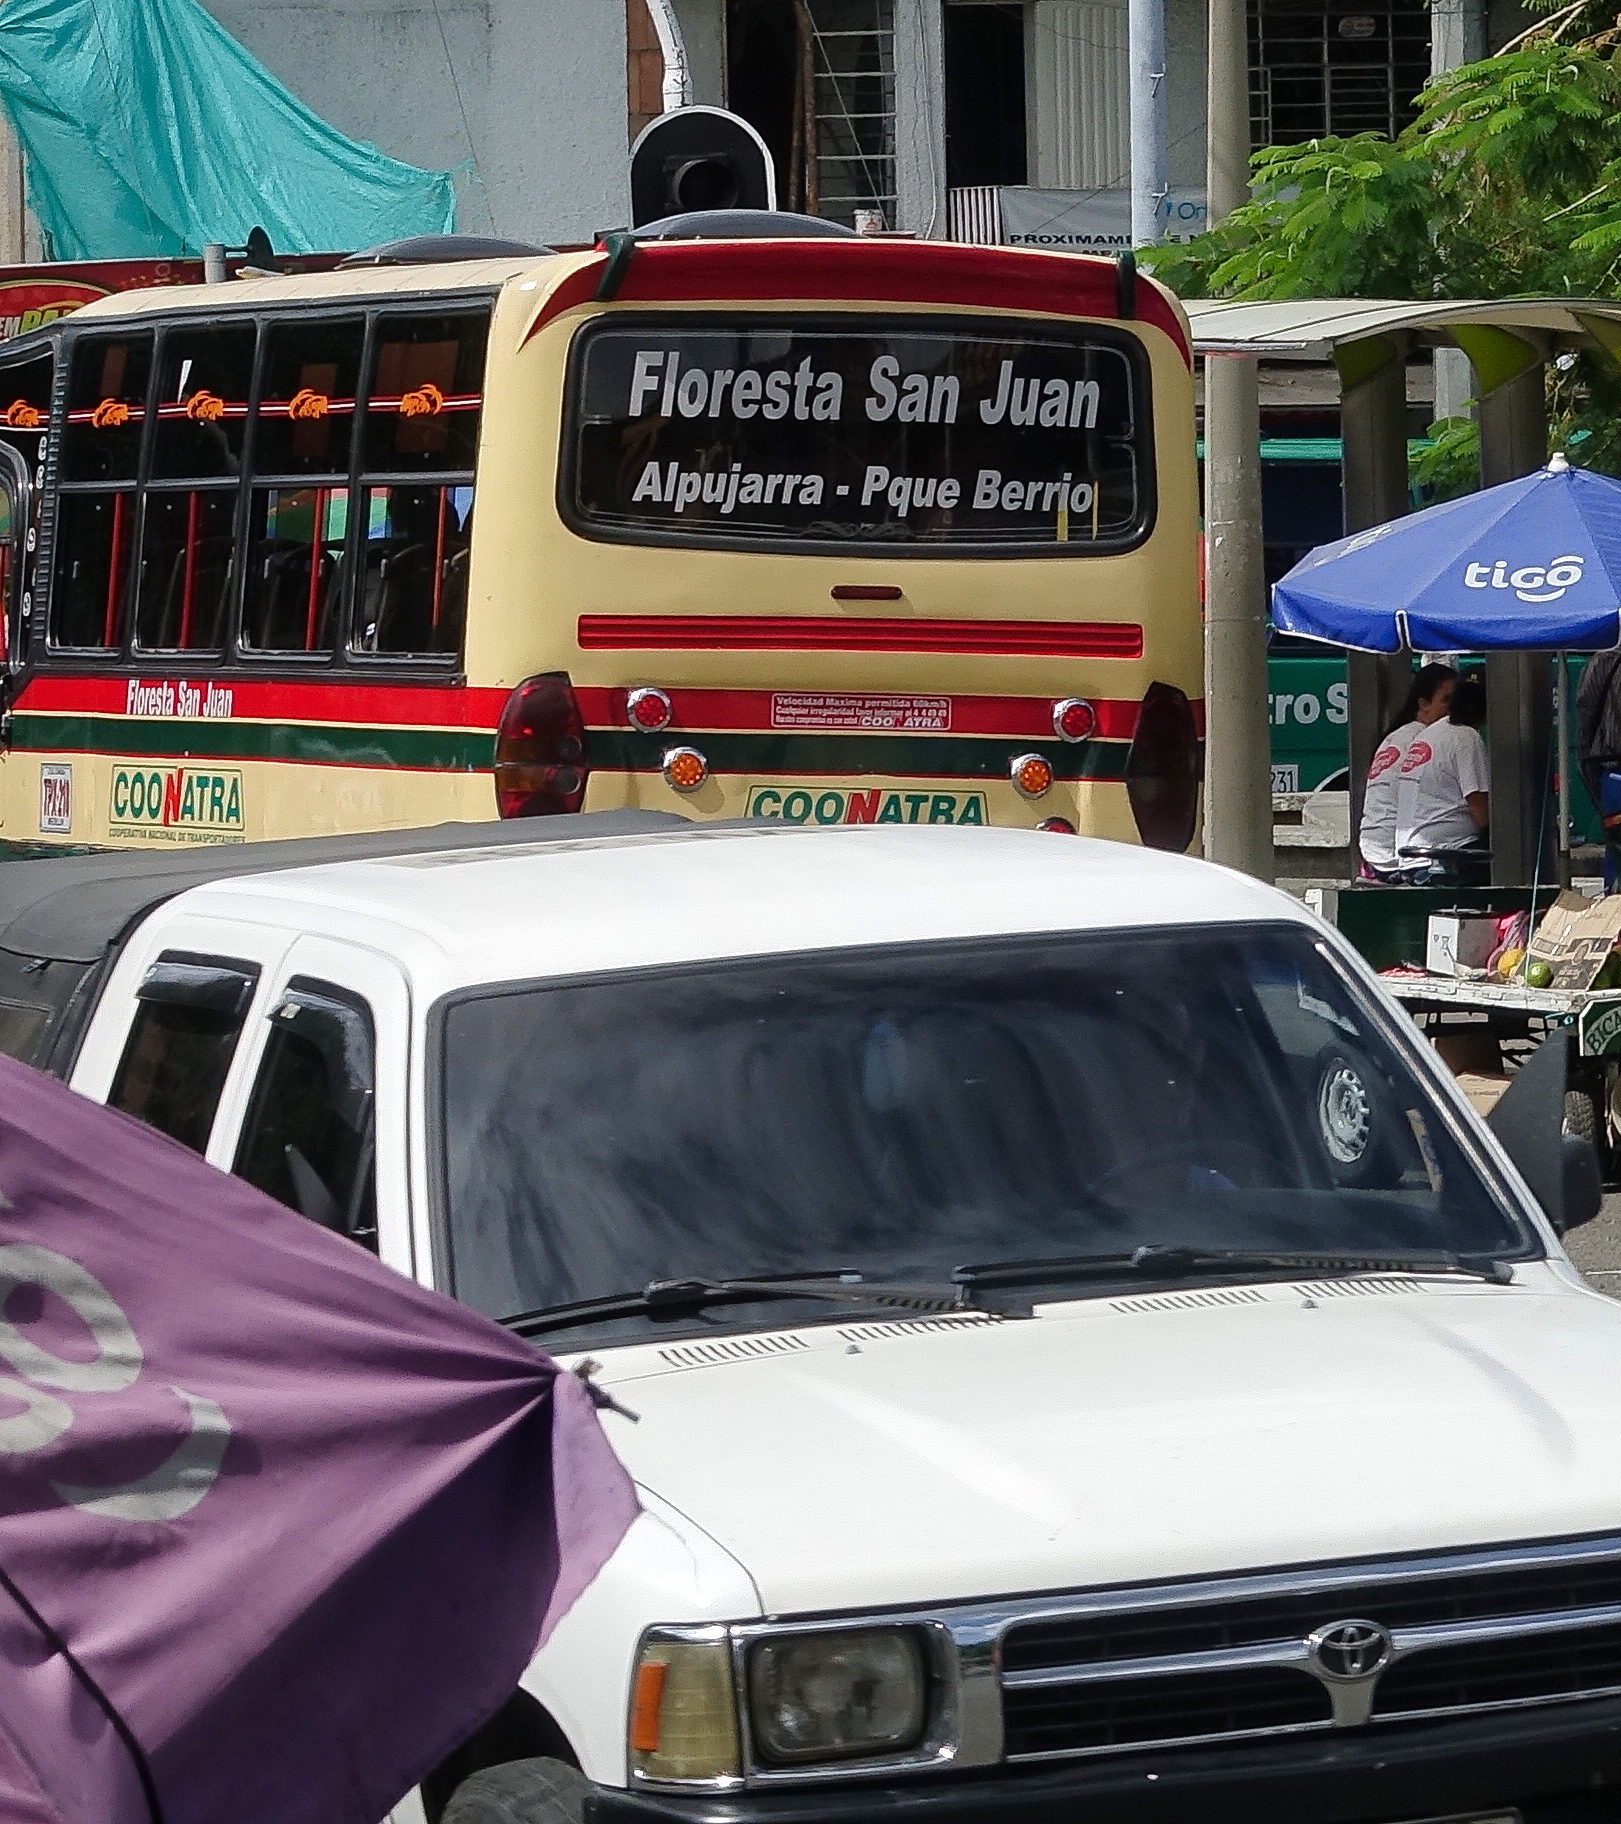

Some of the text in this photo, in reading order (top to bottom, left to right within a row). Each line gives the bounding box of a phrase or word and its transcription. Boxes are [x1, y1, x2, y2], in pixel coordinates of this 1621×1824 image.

[1010, 233, 1182, 246] PROXIMAME
[628, 350, 1101, 429] Floresta San Juan
[632, 461, 823, 513] Alpujarra
[861, 465, 970, 517] Pque
[1464, 555, 1585, 603] tigo
[126, 679, 234, 718] Floresta San Juan
[114, 768, 242, 827] COONATRA
[752, 788, 983, 825] COONATRA
